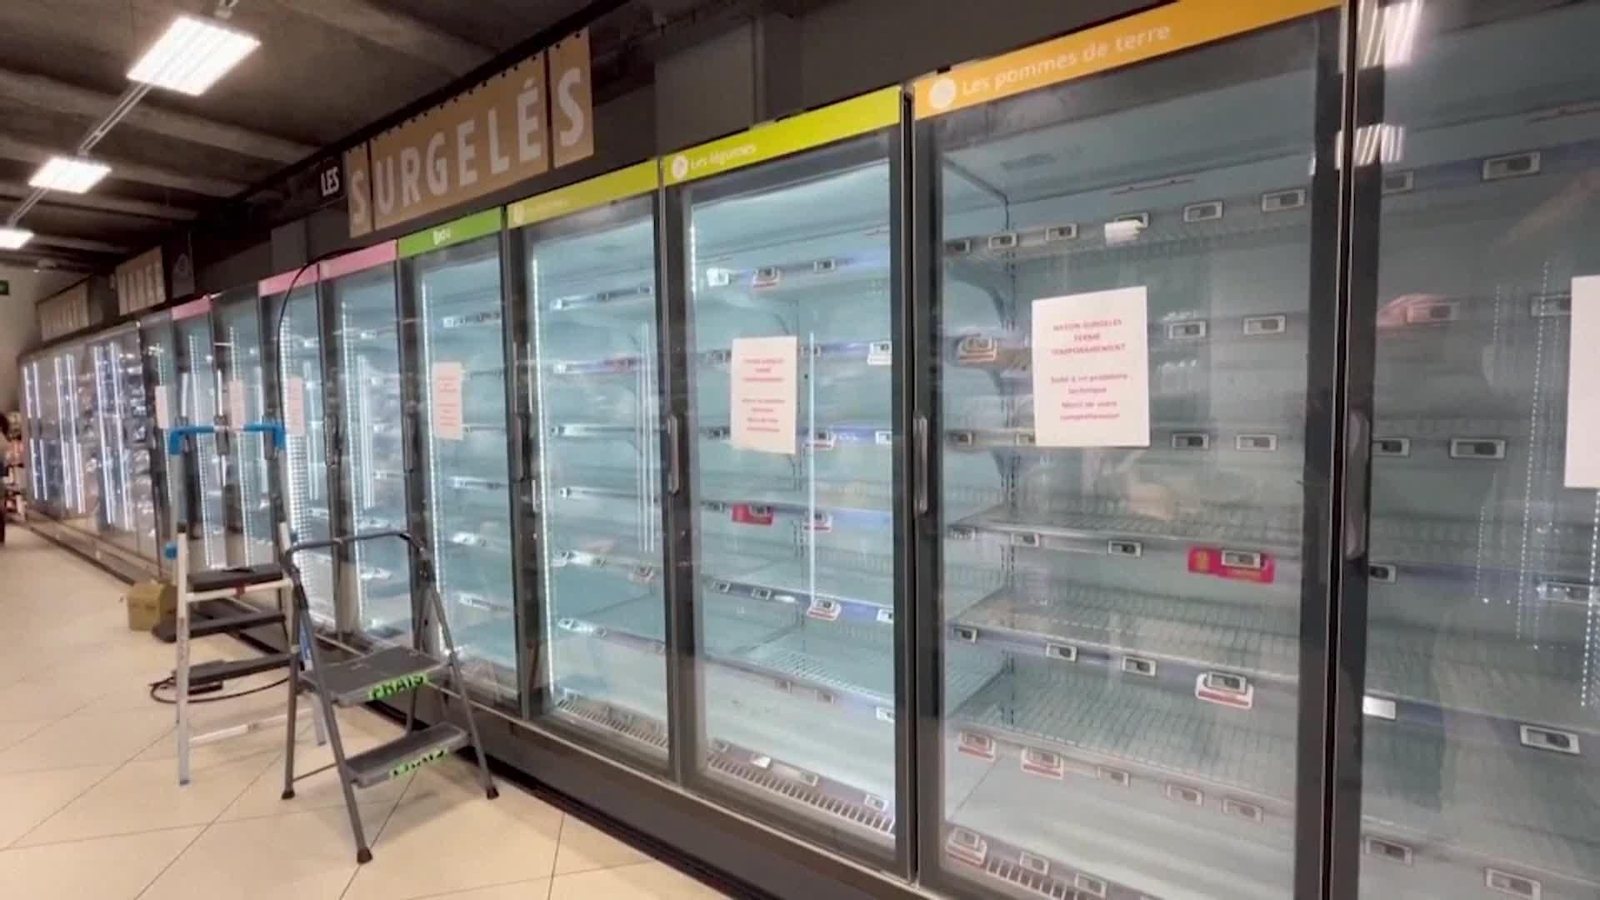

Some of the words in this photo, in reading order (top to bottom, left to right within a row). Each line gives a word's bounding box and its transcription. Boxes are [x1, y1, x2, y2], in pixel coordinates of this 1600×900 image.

[962, 76, 990, 96] Les
[993, 52, 1077, 92] pommes
[1082, 42, 1108, 63] de
[1115, 25, 1171, 52] terre
[350, 67, 585, 223] SURGELÉS
[320, 166, 340, 197] LES
